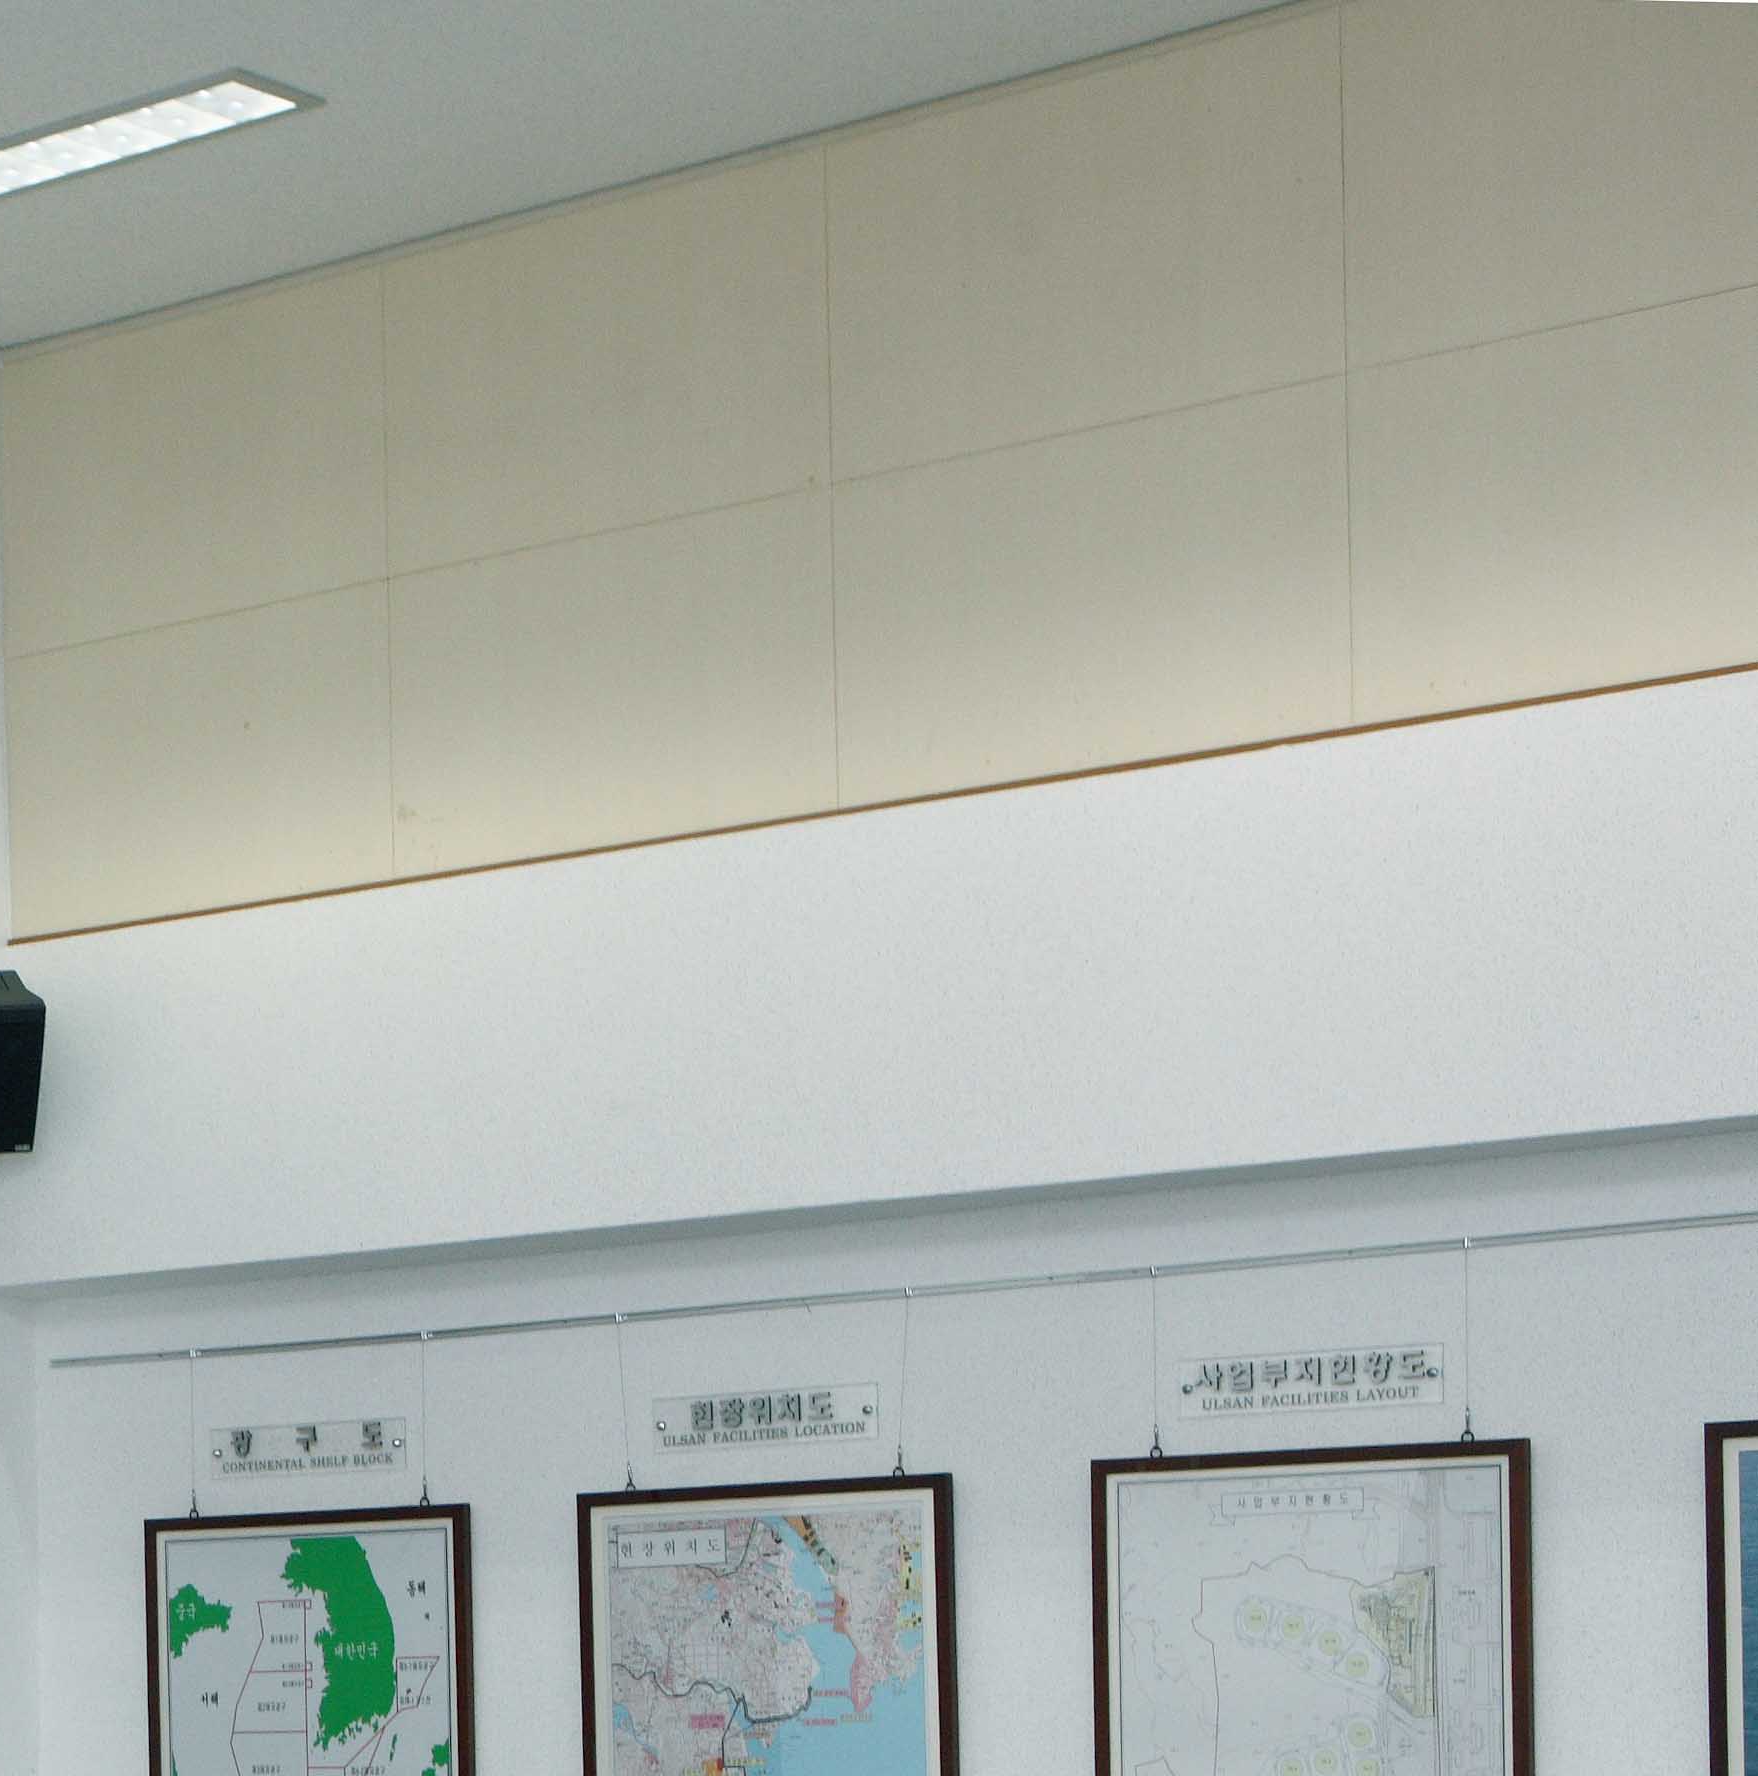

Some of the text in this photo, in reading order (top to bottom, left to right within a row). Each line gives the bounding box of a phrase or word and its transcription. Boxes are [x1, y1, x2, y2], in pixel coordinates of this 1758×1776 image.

[1202, 1386, 1419, 1411] ULSAN FACILITIES LAYOUT
[663, 1421, 866, 1447] ULSAN FACILITIES LOCATION
[222, 1452, 394, 1474] CONTINENTAL SHELF BLOCK
